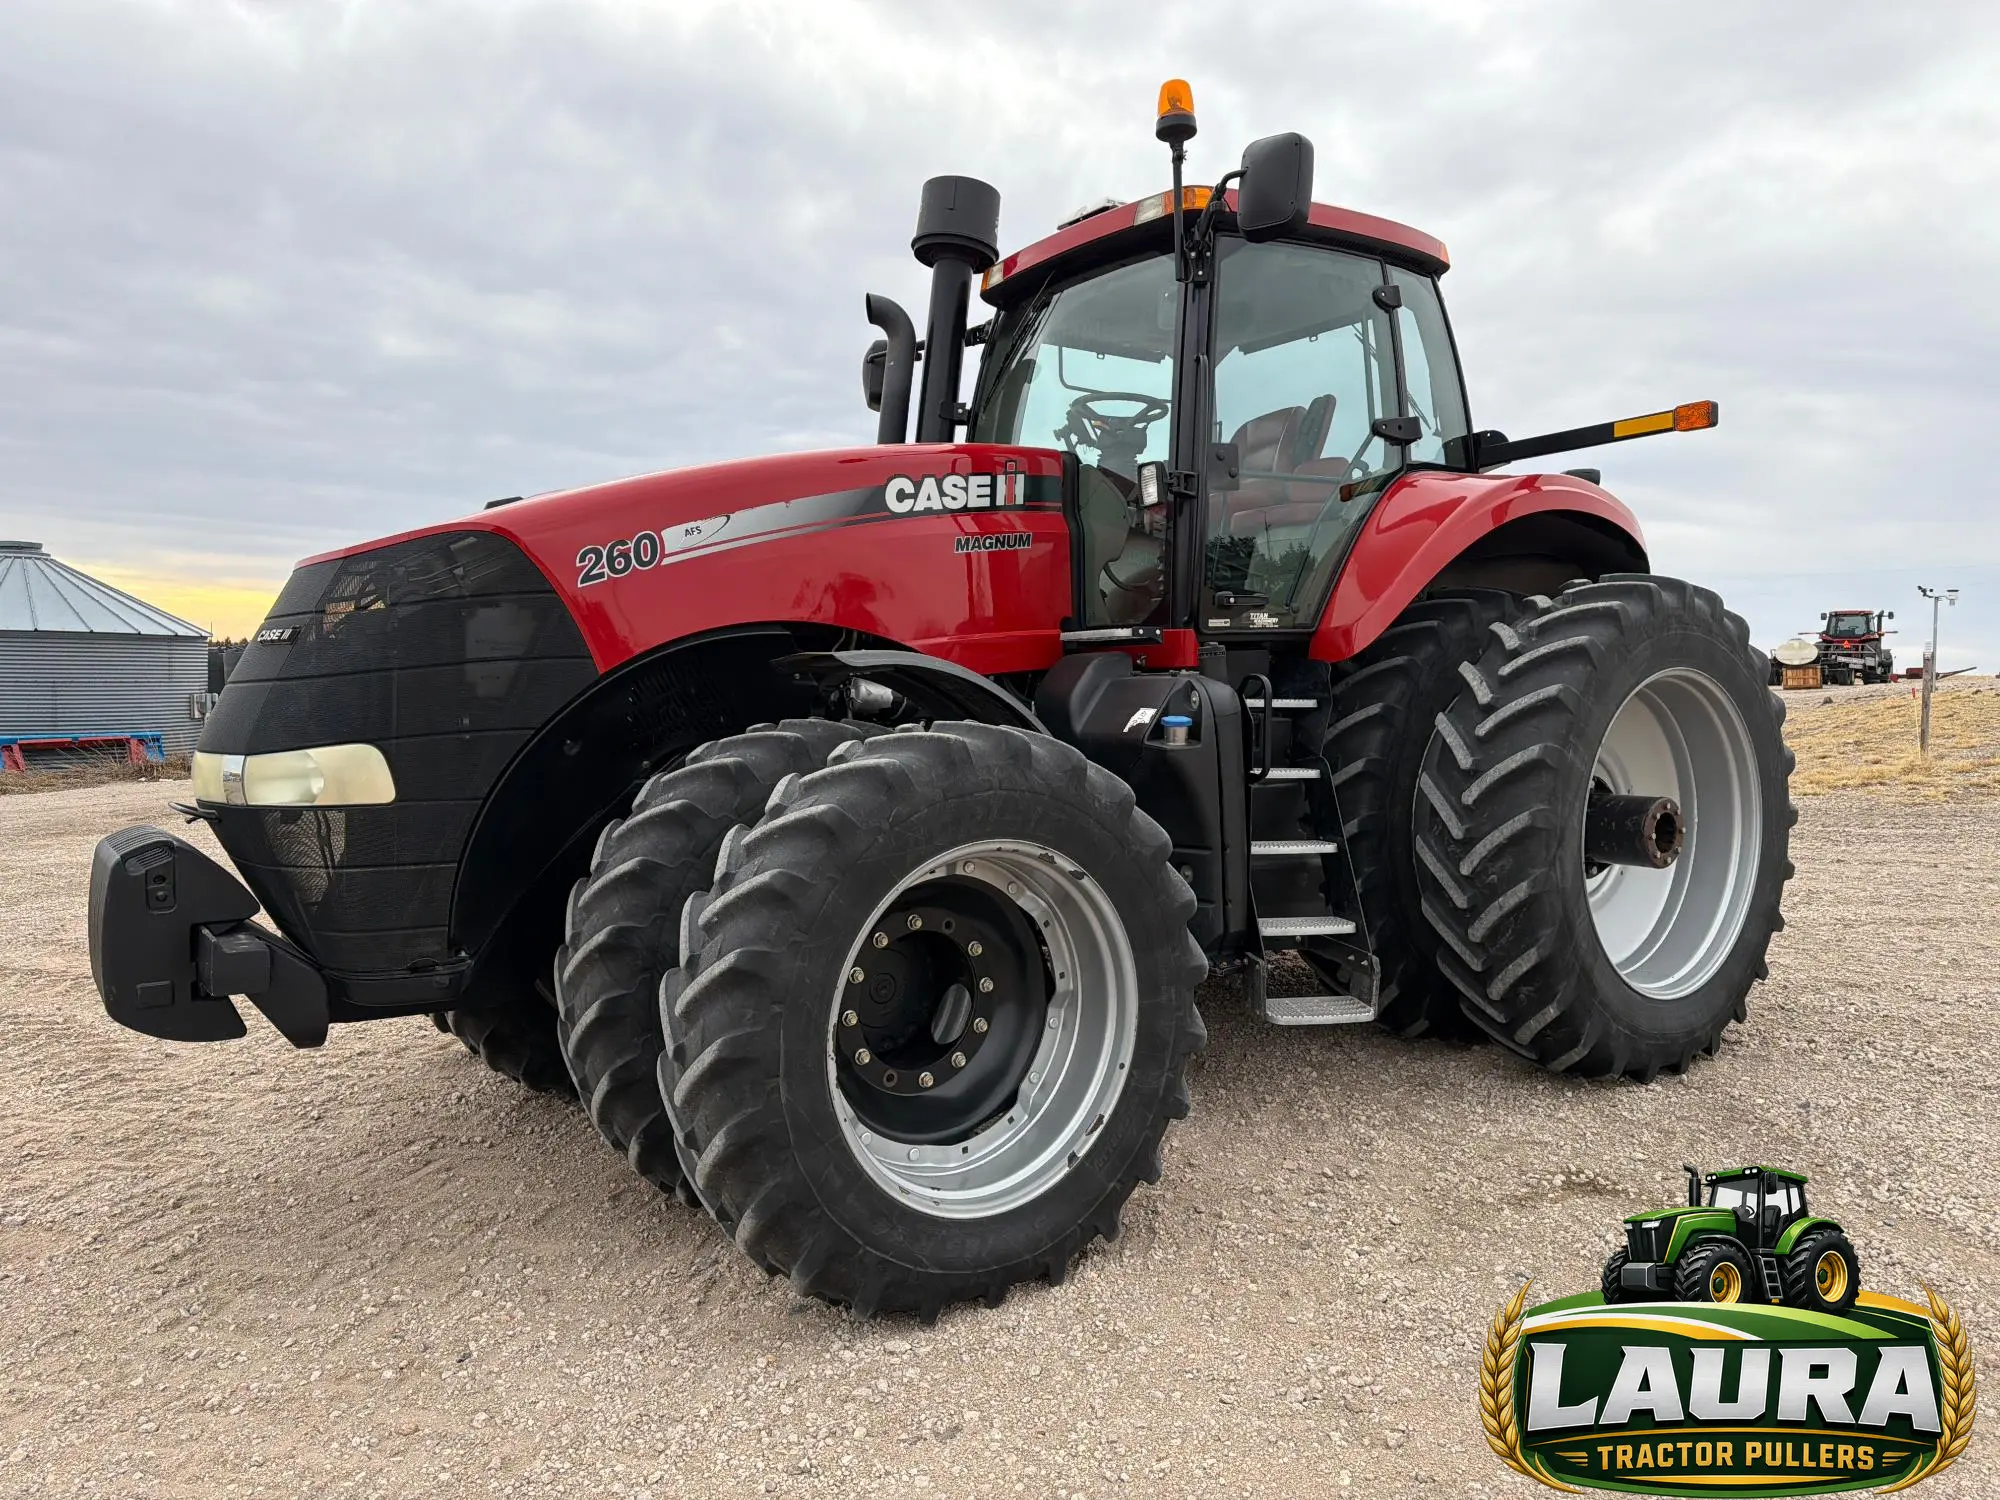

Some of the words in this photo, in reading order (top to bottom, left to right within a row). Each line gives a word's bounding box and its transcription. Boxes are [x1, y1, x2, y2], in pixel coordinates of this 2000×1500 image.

[884, 474, 992, 514] CASE
[684, 526, 702, 537] AFS
[955, 533, 1033, 553] MAGNUM
[576, 530, 660, 588] 260
[257, 629, 283, 641] CASE
